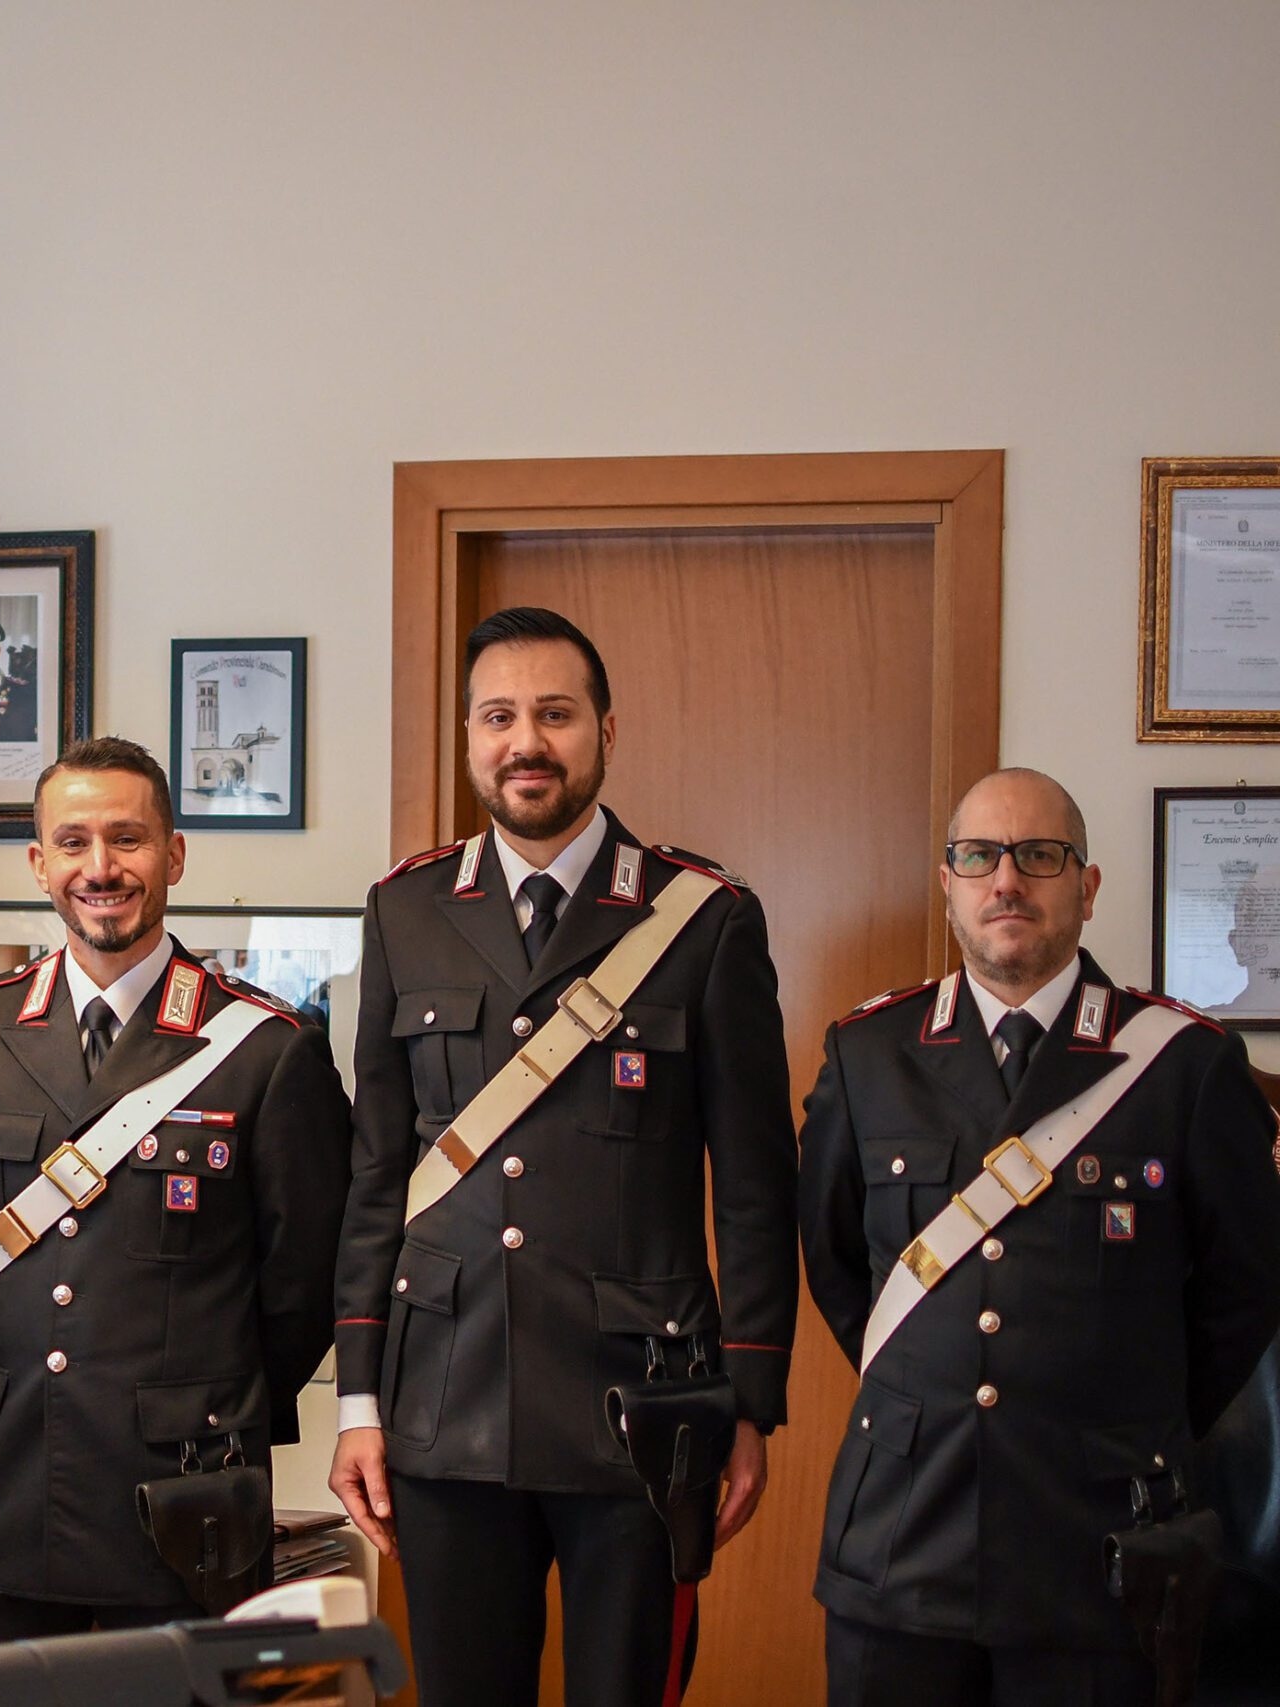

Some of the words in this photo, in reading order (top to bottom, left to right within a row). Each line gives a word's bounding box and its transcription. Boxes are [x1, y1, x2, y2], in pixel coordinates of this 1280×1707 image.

[1237, 539, 1262, 547] DELLA
[1202, 833, 1241, 845] Encomio
[1242, 833, 1279, 848] Semplice
